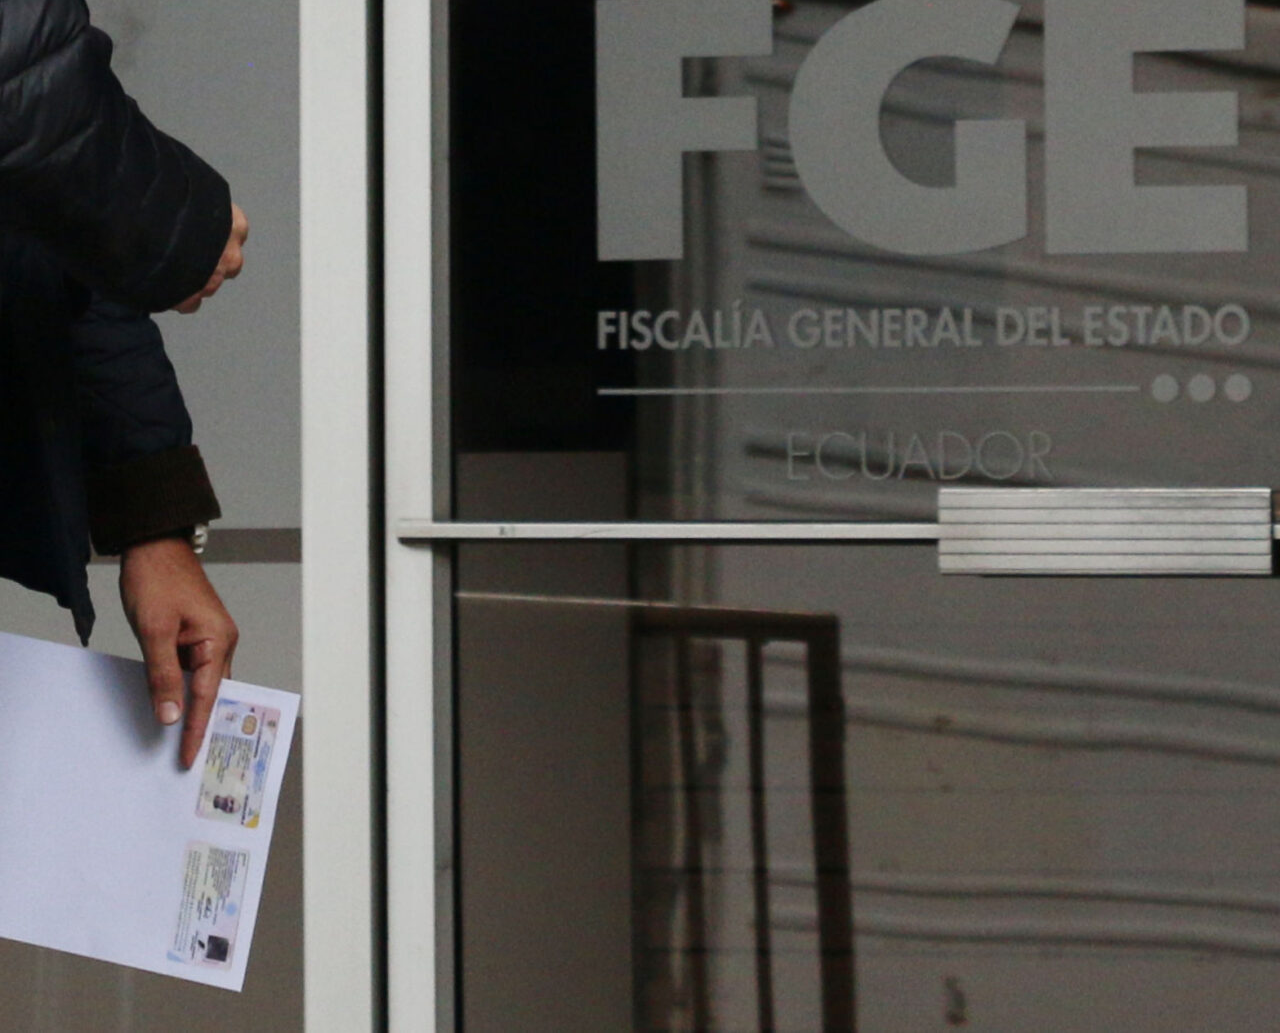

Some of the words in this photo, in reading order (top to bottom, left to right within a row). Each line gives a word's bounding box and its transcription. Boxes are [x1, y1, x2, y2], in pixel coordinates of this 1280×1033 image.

[596, 300, 774, 351] FISCALÍA
[788, 307, 982, 349] GENERAL
[997, 306, 1070, 348] DEL
[1083, 303, 1251, 347] ESTADO
[785, 429, 1054, 481] ECUADOR
